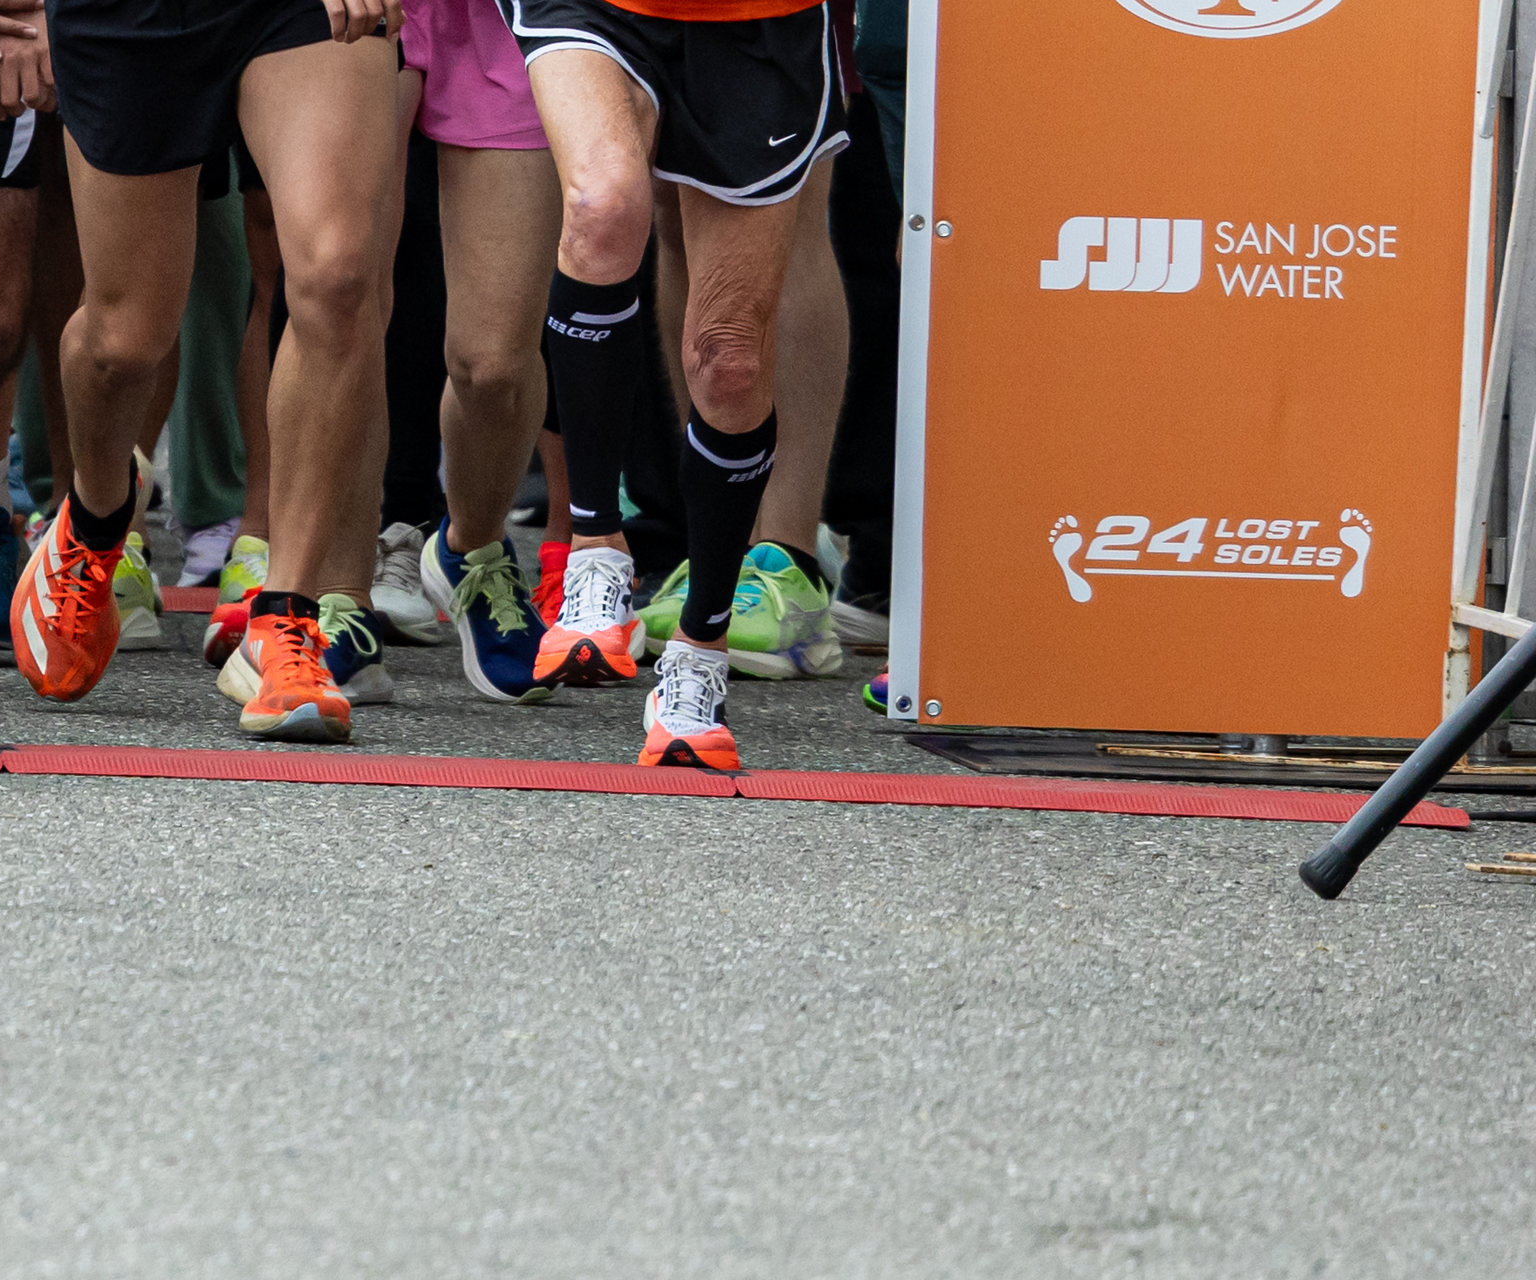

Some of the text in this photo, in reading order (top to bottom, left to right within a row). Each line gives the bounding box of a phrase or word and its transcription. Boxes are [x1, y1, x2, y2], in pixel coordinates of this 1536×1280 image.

[1216, 223, 1397, 259] SAN JOSE
[1218, 265, 1344, 300] WATER
[567, 326, 612, 342] cep
[1087, 517, 1320, 563] 24 LOST
[1215, 540, 1344, 567] SOLES
